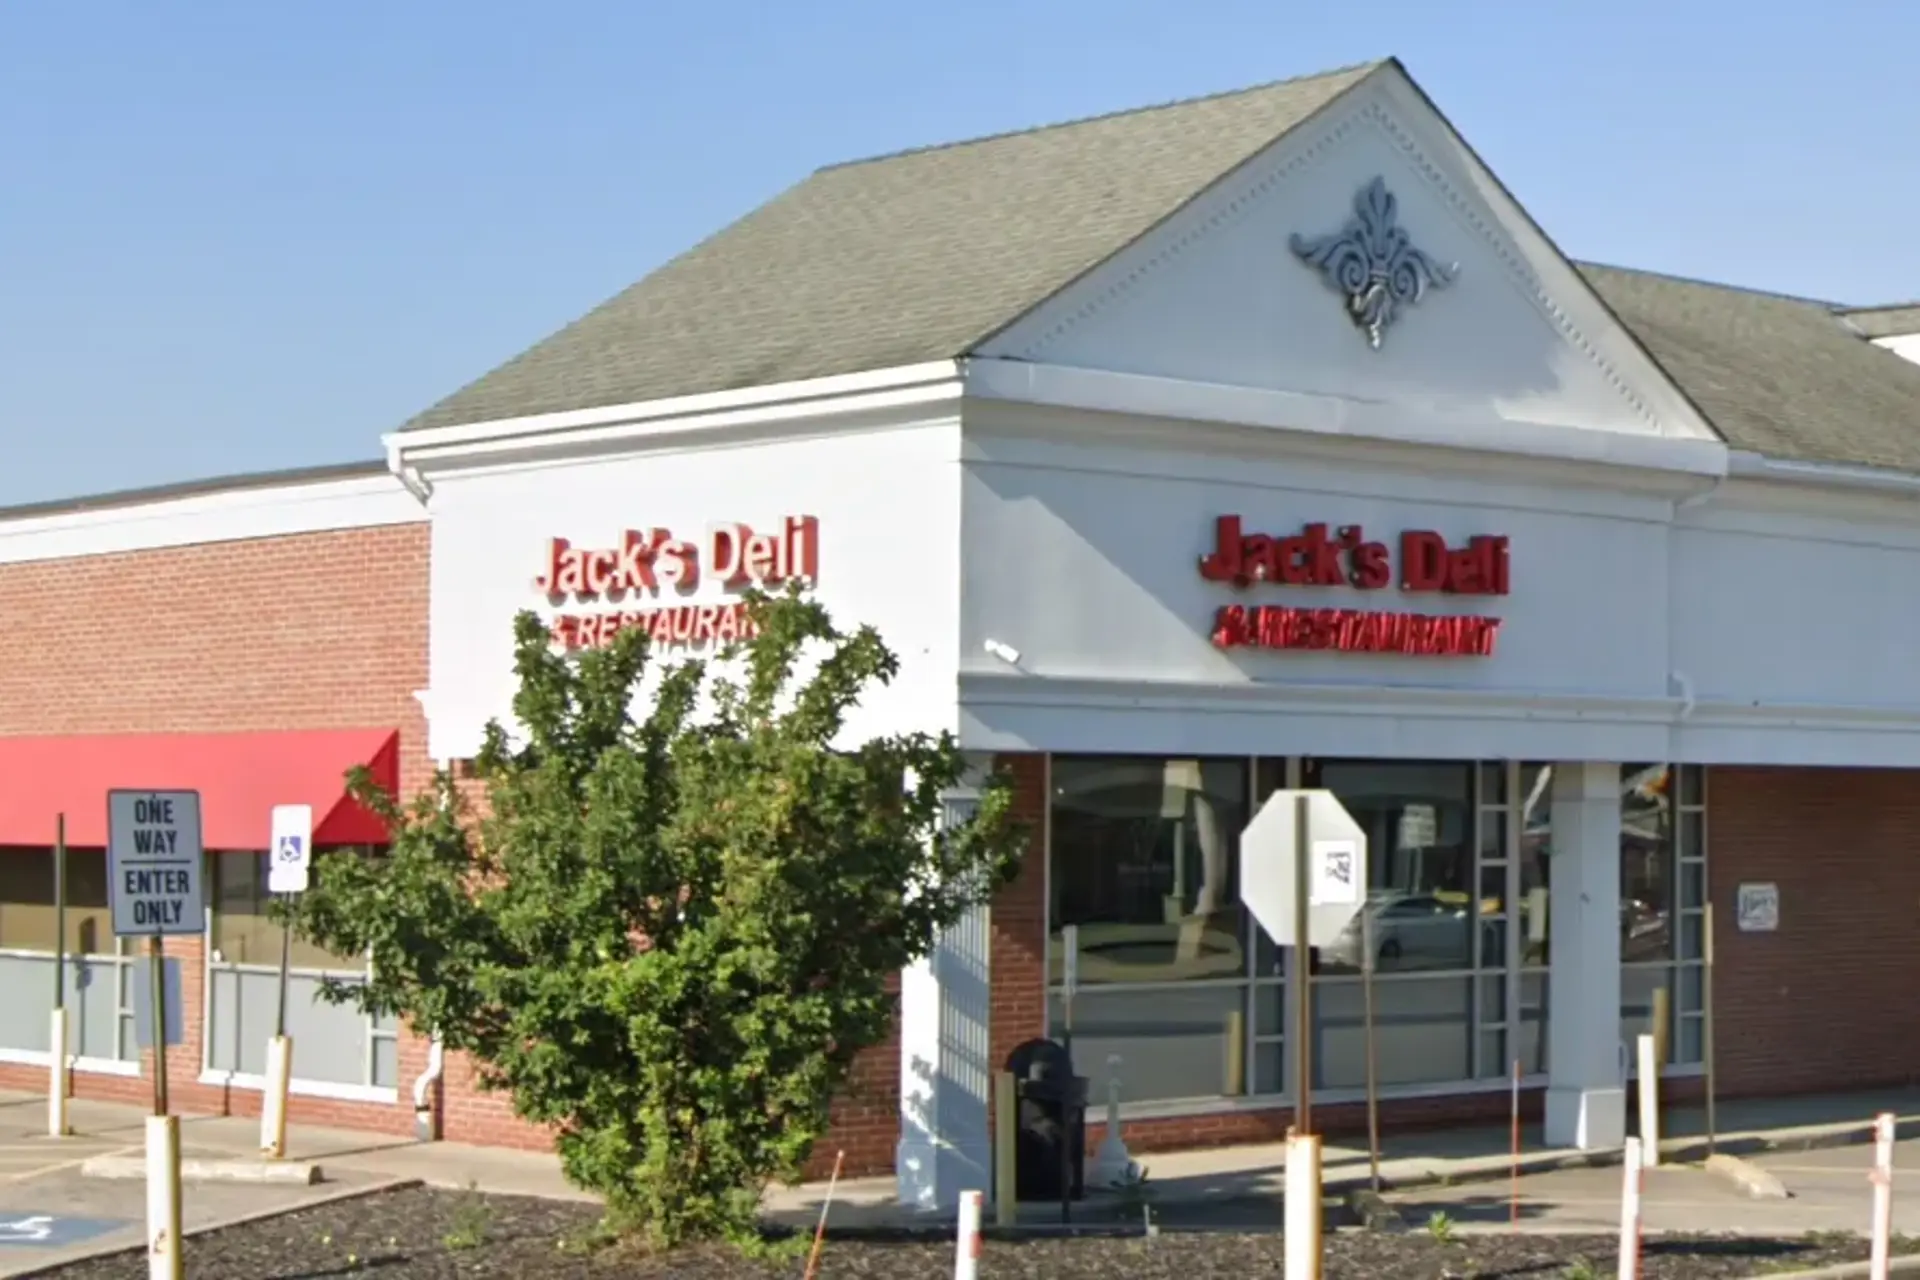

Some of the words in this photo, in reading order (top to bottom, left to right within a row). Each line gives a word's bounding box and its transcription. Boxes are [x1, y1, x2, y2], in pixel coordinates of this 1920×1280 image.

[533, 528, 698, 602] Jack's
[707, 515, 818, 593] Deli
[1199, 514, 1390, 590] Jack's
[1400, 530, 1509, 596] Deli
[576, 602, 768, 648] RESTAURAN
[1251, 606, 1501, 656] RESTAURANT
[135, 799, 174, 824] ONE
[133, 830, 177, 854] WAY
[124, 870, 190, 895] ENTER
[134, 901, 182, 925] ONLY
